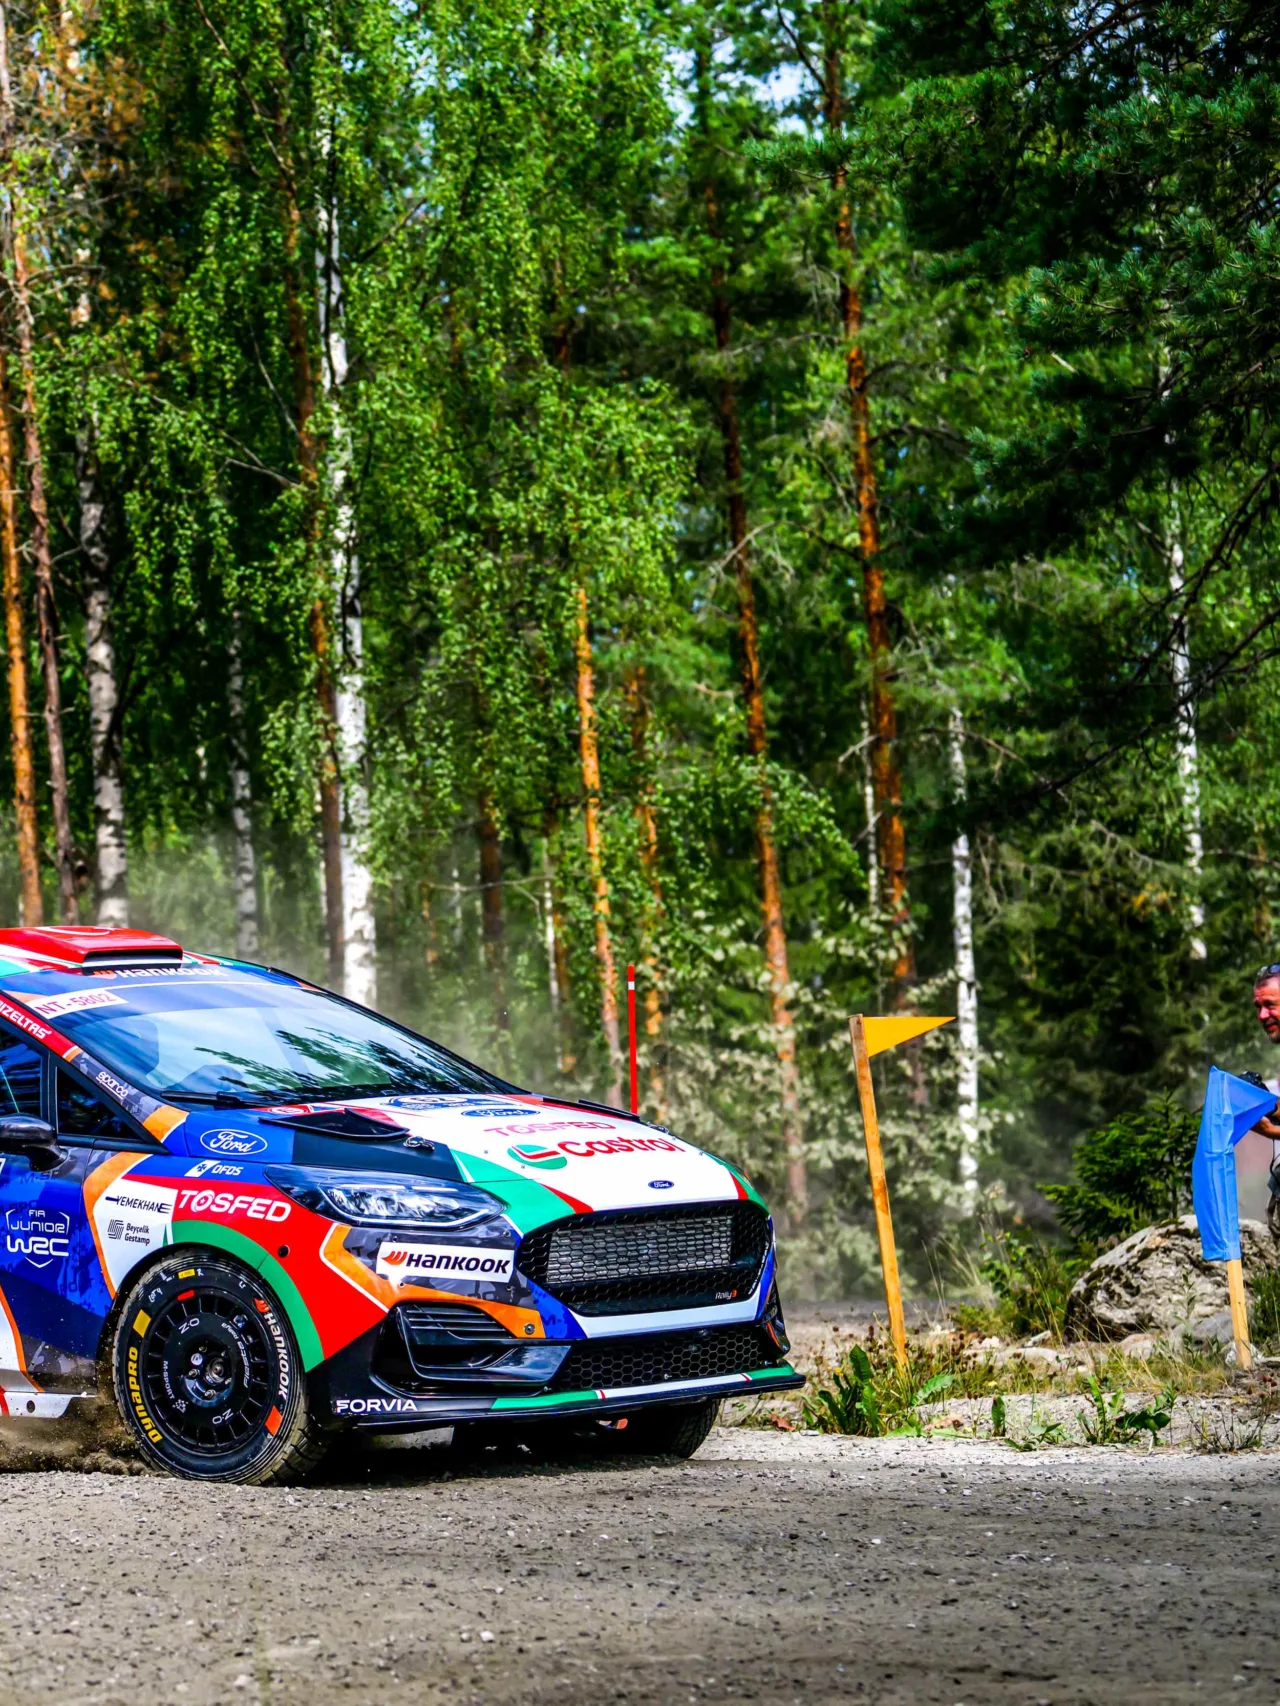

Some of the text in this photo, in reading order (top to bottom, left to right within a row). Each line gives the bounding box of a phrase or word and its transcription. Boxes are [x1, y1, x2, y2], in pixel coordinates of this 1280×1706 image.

[483, 1121, 617, 1137] TOSFED
[208, 1130, 259, 1153] Ford
[557, 1136, 686, 1157] Castrol
[211, 1165, 244, 1176] DFDS
[28, 1209, 46, 1218] FIA
[178, 1189, 292, 1222] TOSFED
[6, 1235, 70, 1257] WRC
[124, 1233, 150, 1246] Gestamp
[336, 1399, 418, 1413] FORVIA
